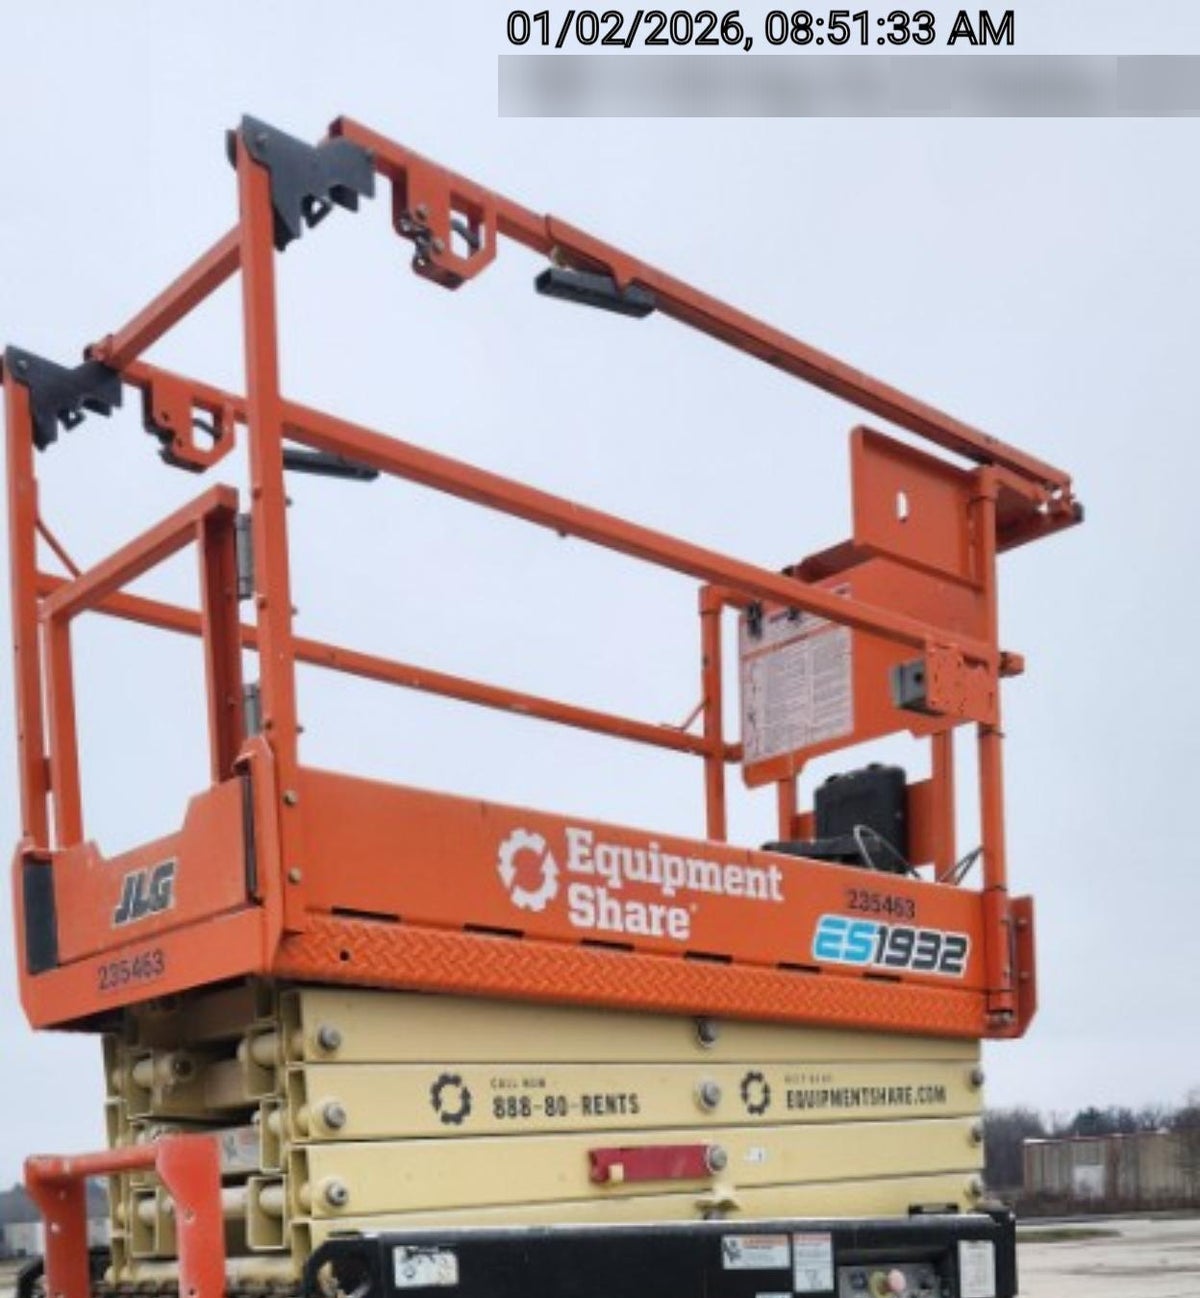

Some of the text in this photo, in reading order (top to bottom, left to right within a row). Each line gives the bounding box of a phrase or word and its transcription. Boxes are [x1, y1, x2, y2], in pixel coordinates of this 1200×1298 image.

[565, 826, 784, 901] Equipment
[113, 861, 176, 925] JLG
[847, 888, 916, 919] 235463
[98, 949, 165, 991] 235463
[813, 915, 969, 976] ES1932
[786, 1084, 948, 1110] EQUIPMENTSHARE.COM
